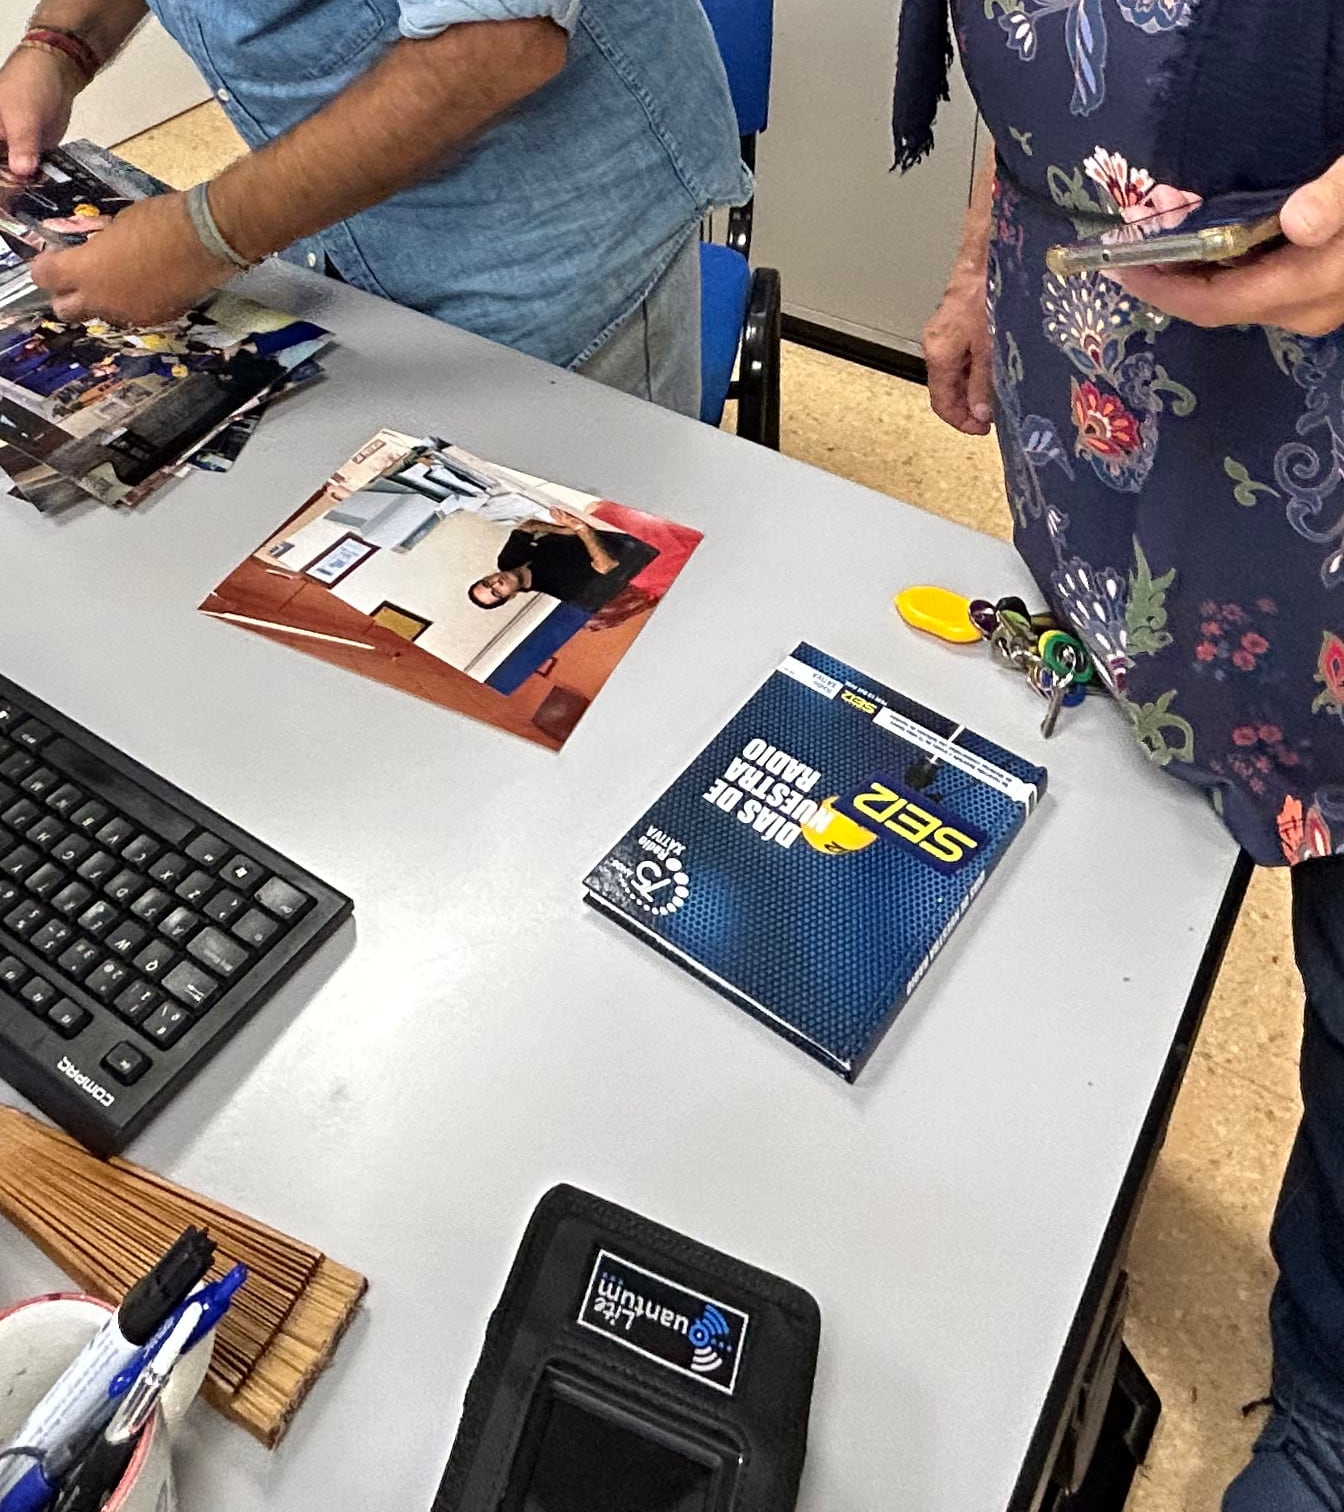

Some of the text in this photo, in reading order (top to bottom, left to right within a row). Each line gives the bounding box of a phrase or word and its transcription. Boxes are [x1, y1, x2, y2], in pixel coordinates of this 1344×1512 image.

[742, 738, 821, 793] RADIO
[702, 778, 801, 849] DÍAS DE
[724, 756, 835, 834] NUESTRA
[638, 835, 670, 861] Radio
[853, 782, 978, 863] SER
[631, 860, 672, 903] 75
[57, 1056, 115, 1107] COMPAQ
[594, 1297, 636, 1330] Lite
